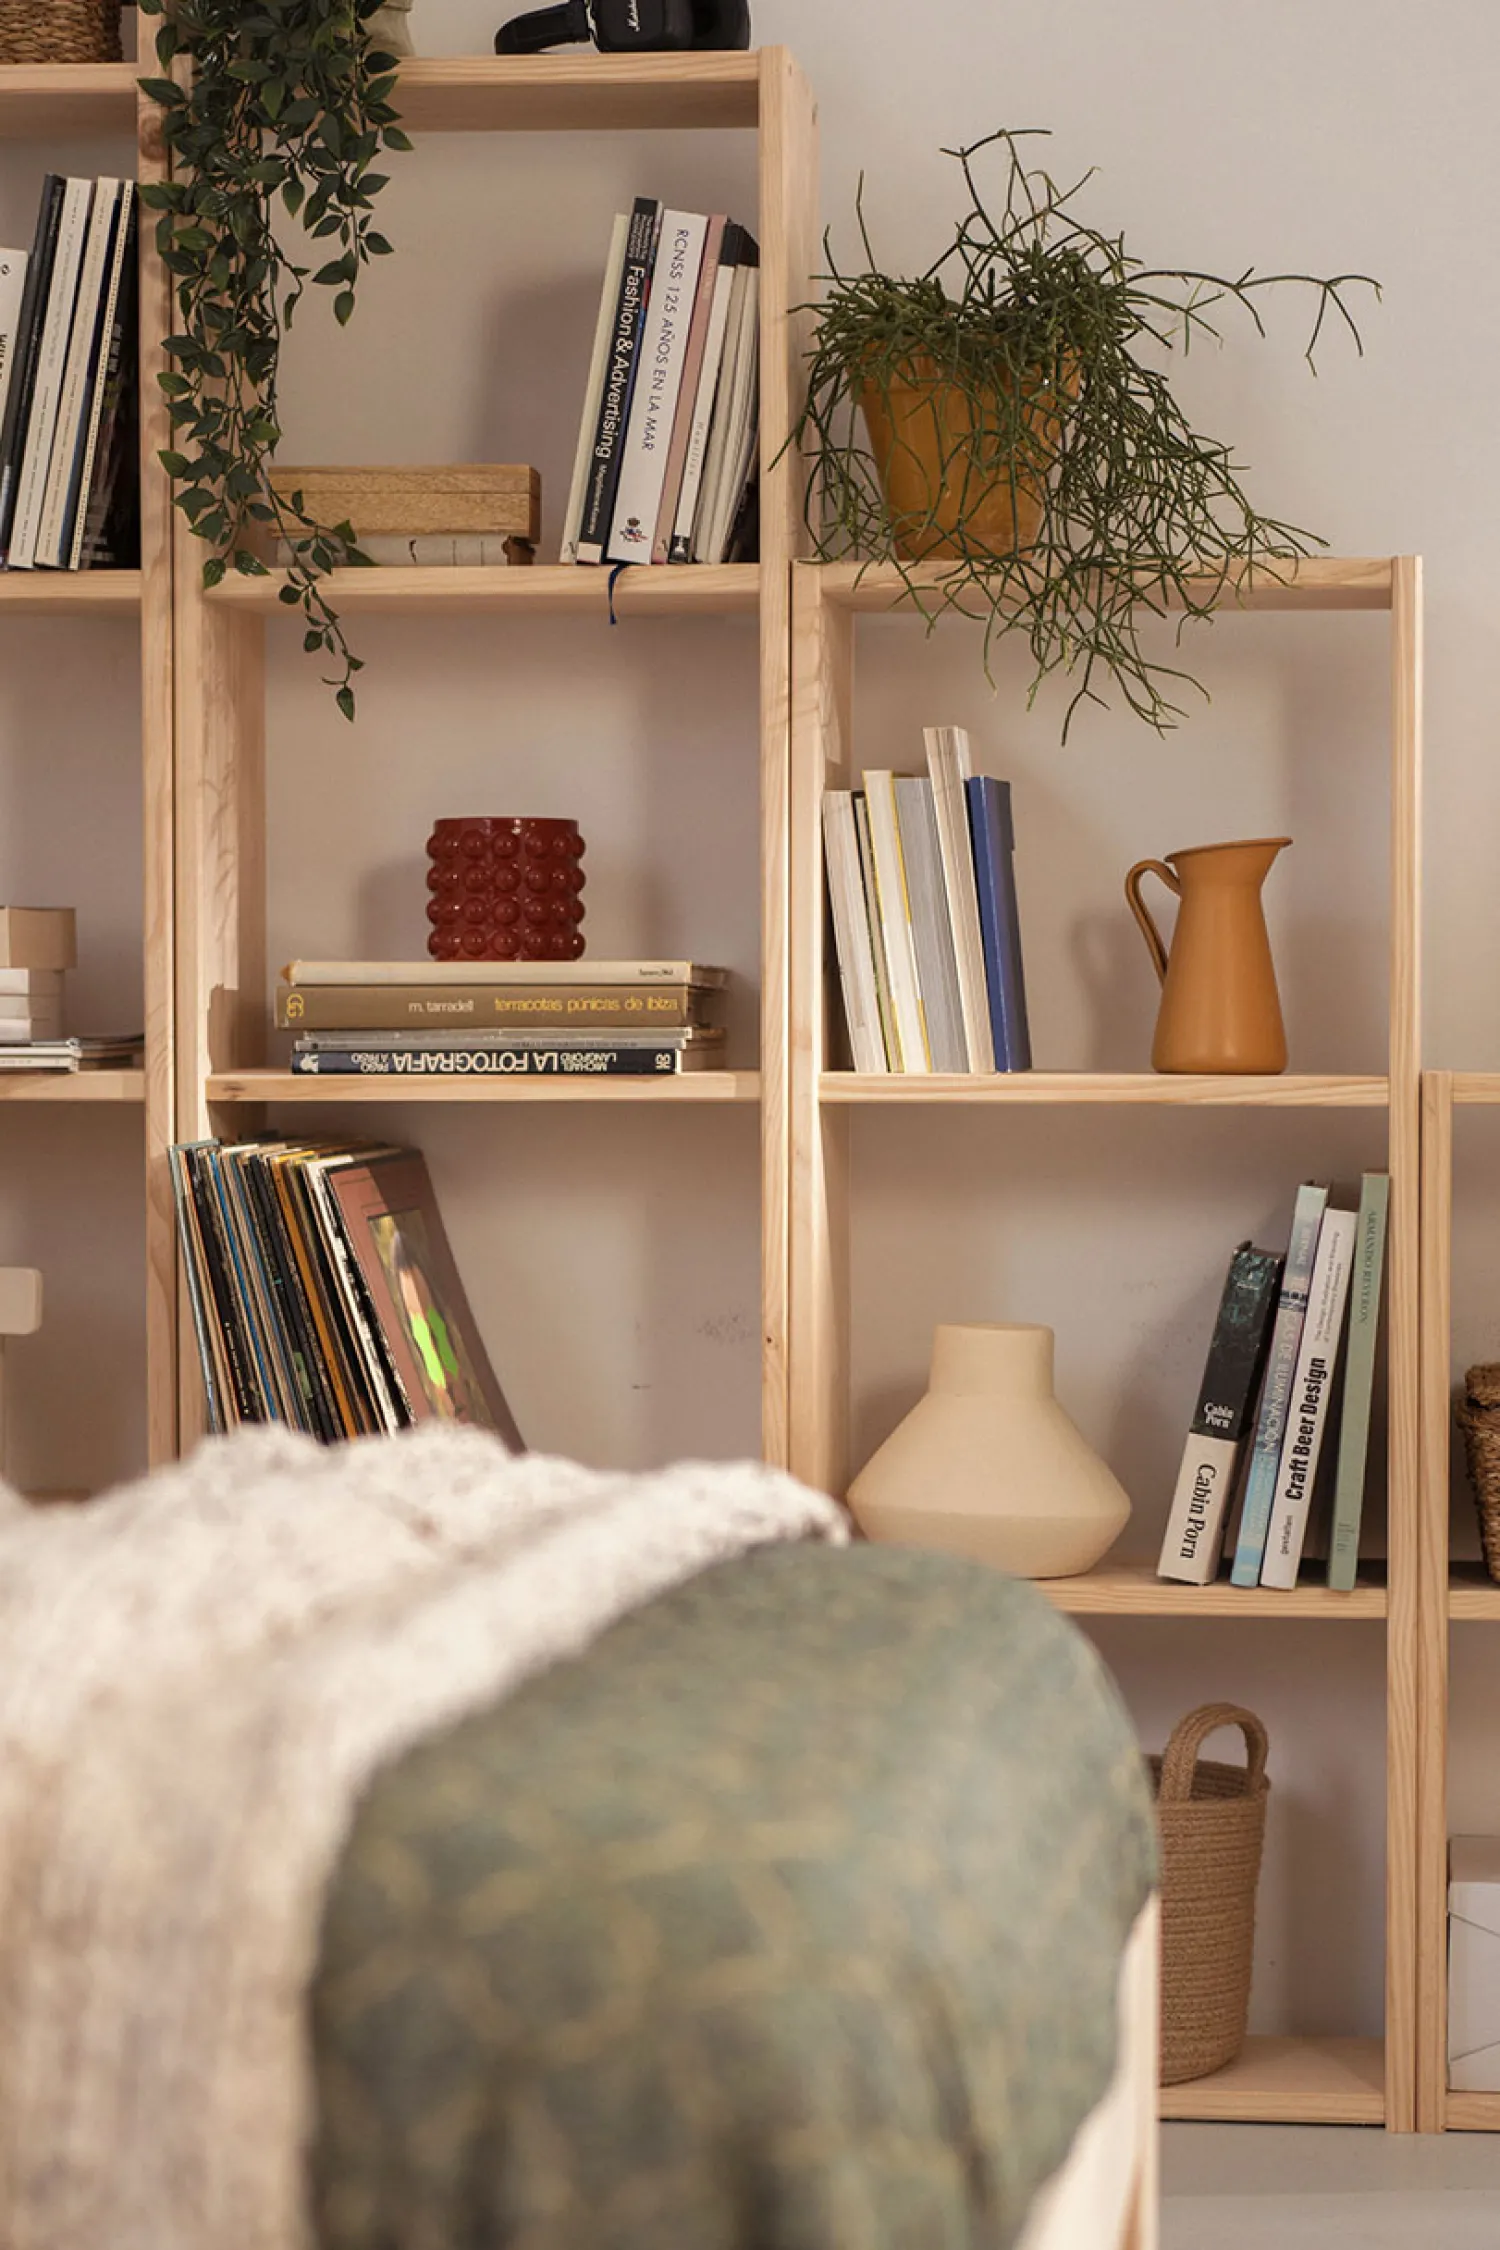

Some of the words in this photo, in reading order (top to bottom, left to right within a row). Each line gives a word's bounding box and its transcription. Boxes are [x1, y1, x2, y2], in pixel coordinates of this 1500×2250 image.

[668, 228, 691, 280] RCNSS
[617, 265, 646, 336] Fashion
[663, 287, 681, 314] 125
[614, 336, 635, 353] &
[655, 318, 677, 365] AÑOS
[651, 369, 667, 392] EN
[595, 354, 631, 459] Advertising
[647, 395, 663, 412] LA
[641, 416, 658, 451] MAR
[408, 1001, 424, 1012] m.
[426, 999, 475, 1013] tarradell
[494, 997, 563, 1012] terracotas
[567, 996, 621, 1014] púnicas
[624, 996, 643, 1011] de
[391, 1052, 530, 1073] FOTOGRAFIA
[532, 1052, 559, 1073] LA
[1300, 1357, 1329, 1415] Design
[1203, 1402, 1234, 1420] Cabin
[1293, 1417, 1316, 1456] Beer
[1189, 1463, 1217, 1515] Cabin
[1285, 1452, 1309, 1501] Craft
[1179, 1516, 1207, 1560] Porn
